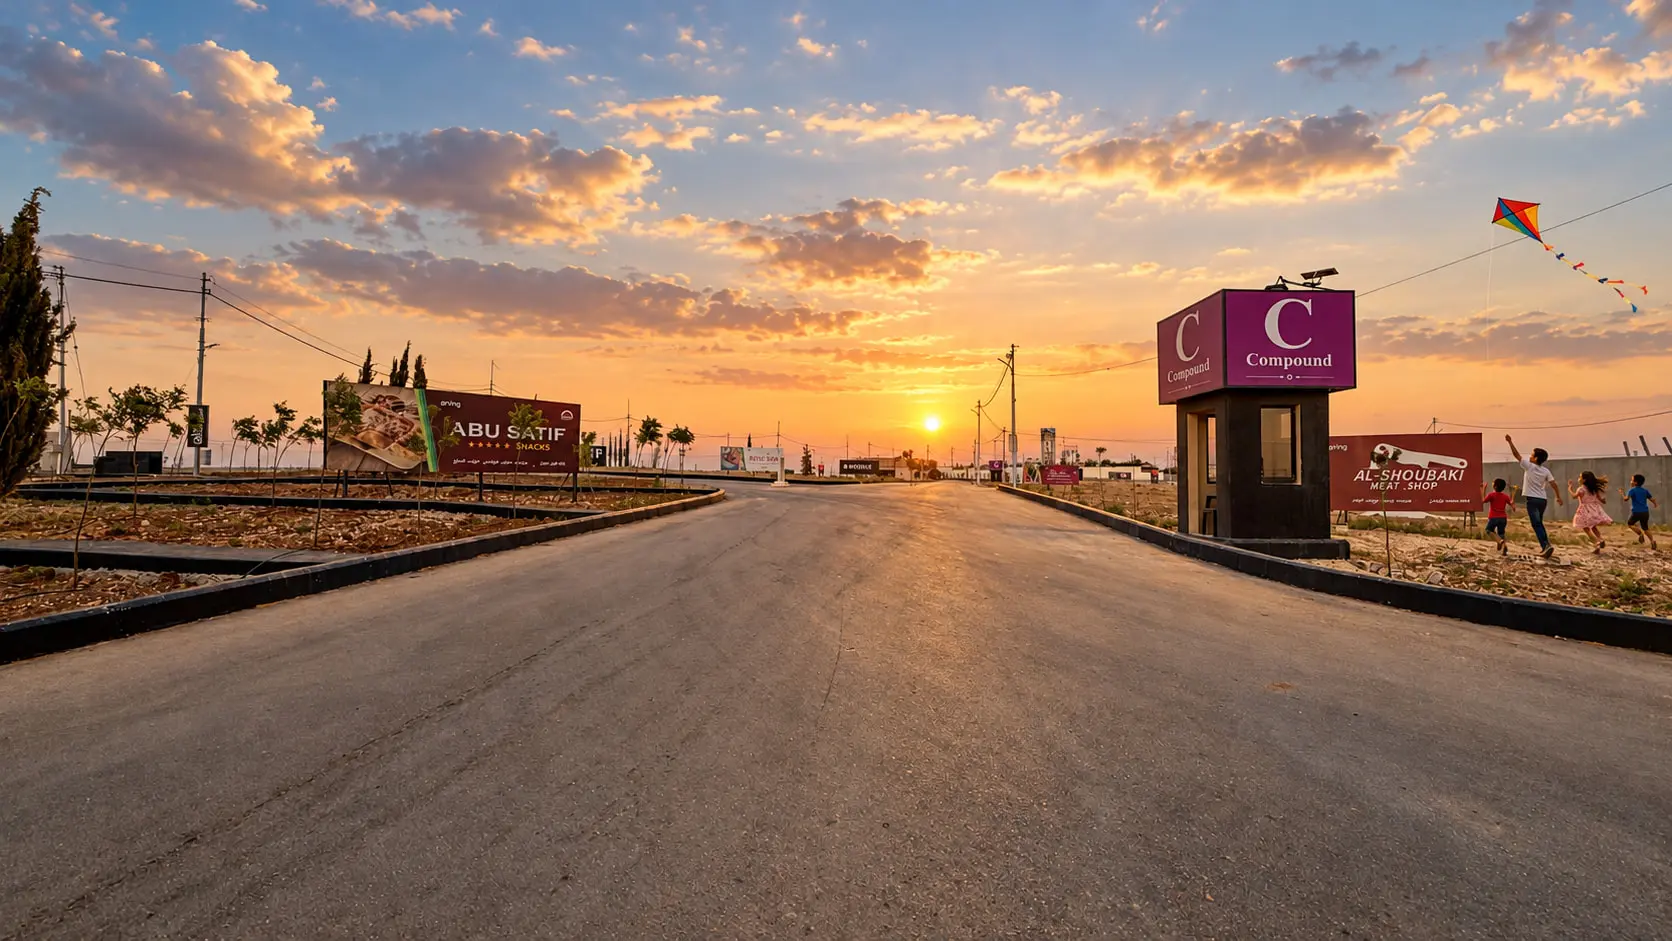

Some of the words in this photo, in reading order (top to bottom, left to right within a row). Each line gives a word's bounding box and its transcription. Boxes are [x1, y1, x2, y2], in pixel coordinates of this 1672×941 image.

[1264, 298, 1313, 350] C
[1175, 309, 1200, 362] C
[1246, 352, 1332, 369] Compound
[1167, 358, 1210, 383] Compound
[450, 421, 500, 438] ABU
[507, 425, 566, 441] SATIF
[516, 442, 551, 451] SNACKS
[1353, 469, 1465, 481] AL-SHOUBAKI
[1370, 482, 1399, 490] MEAT
